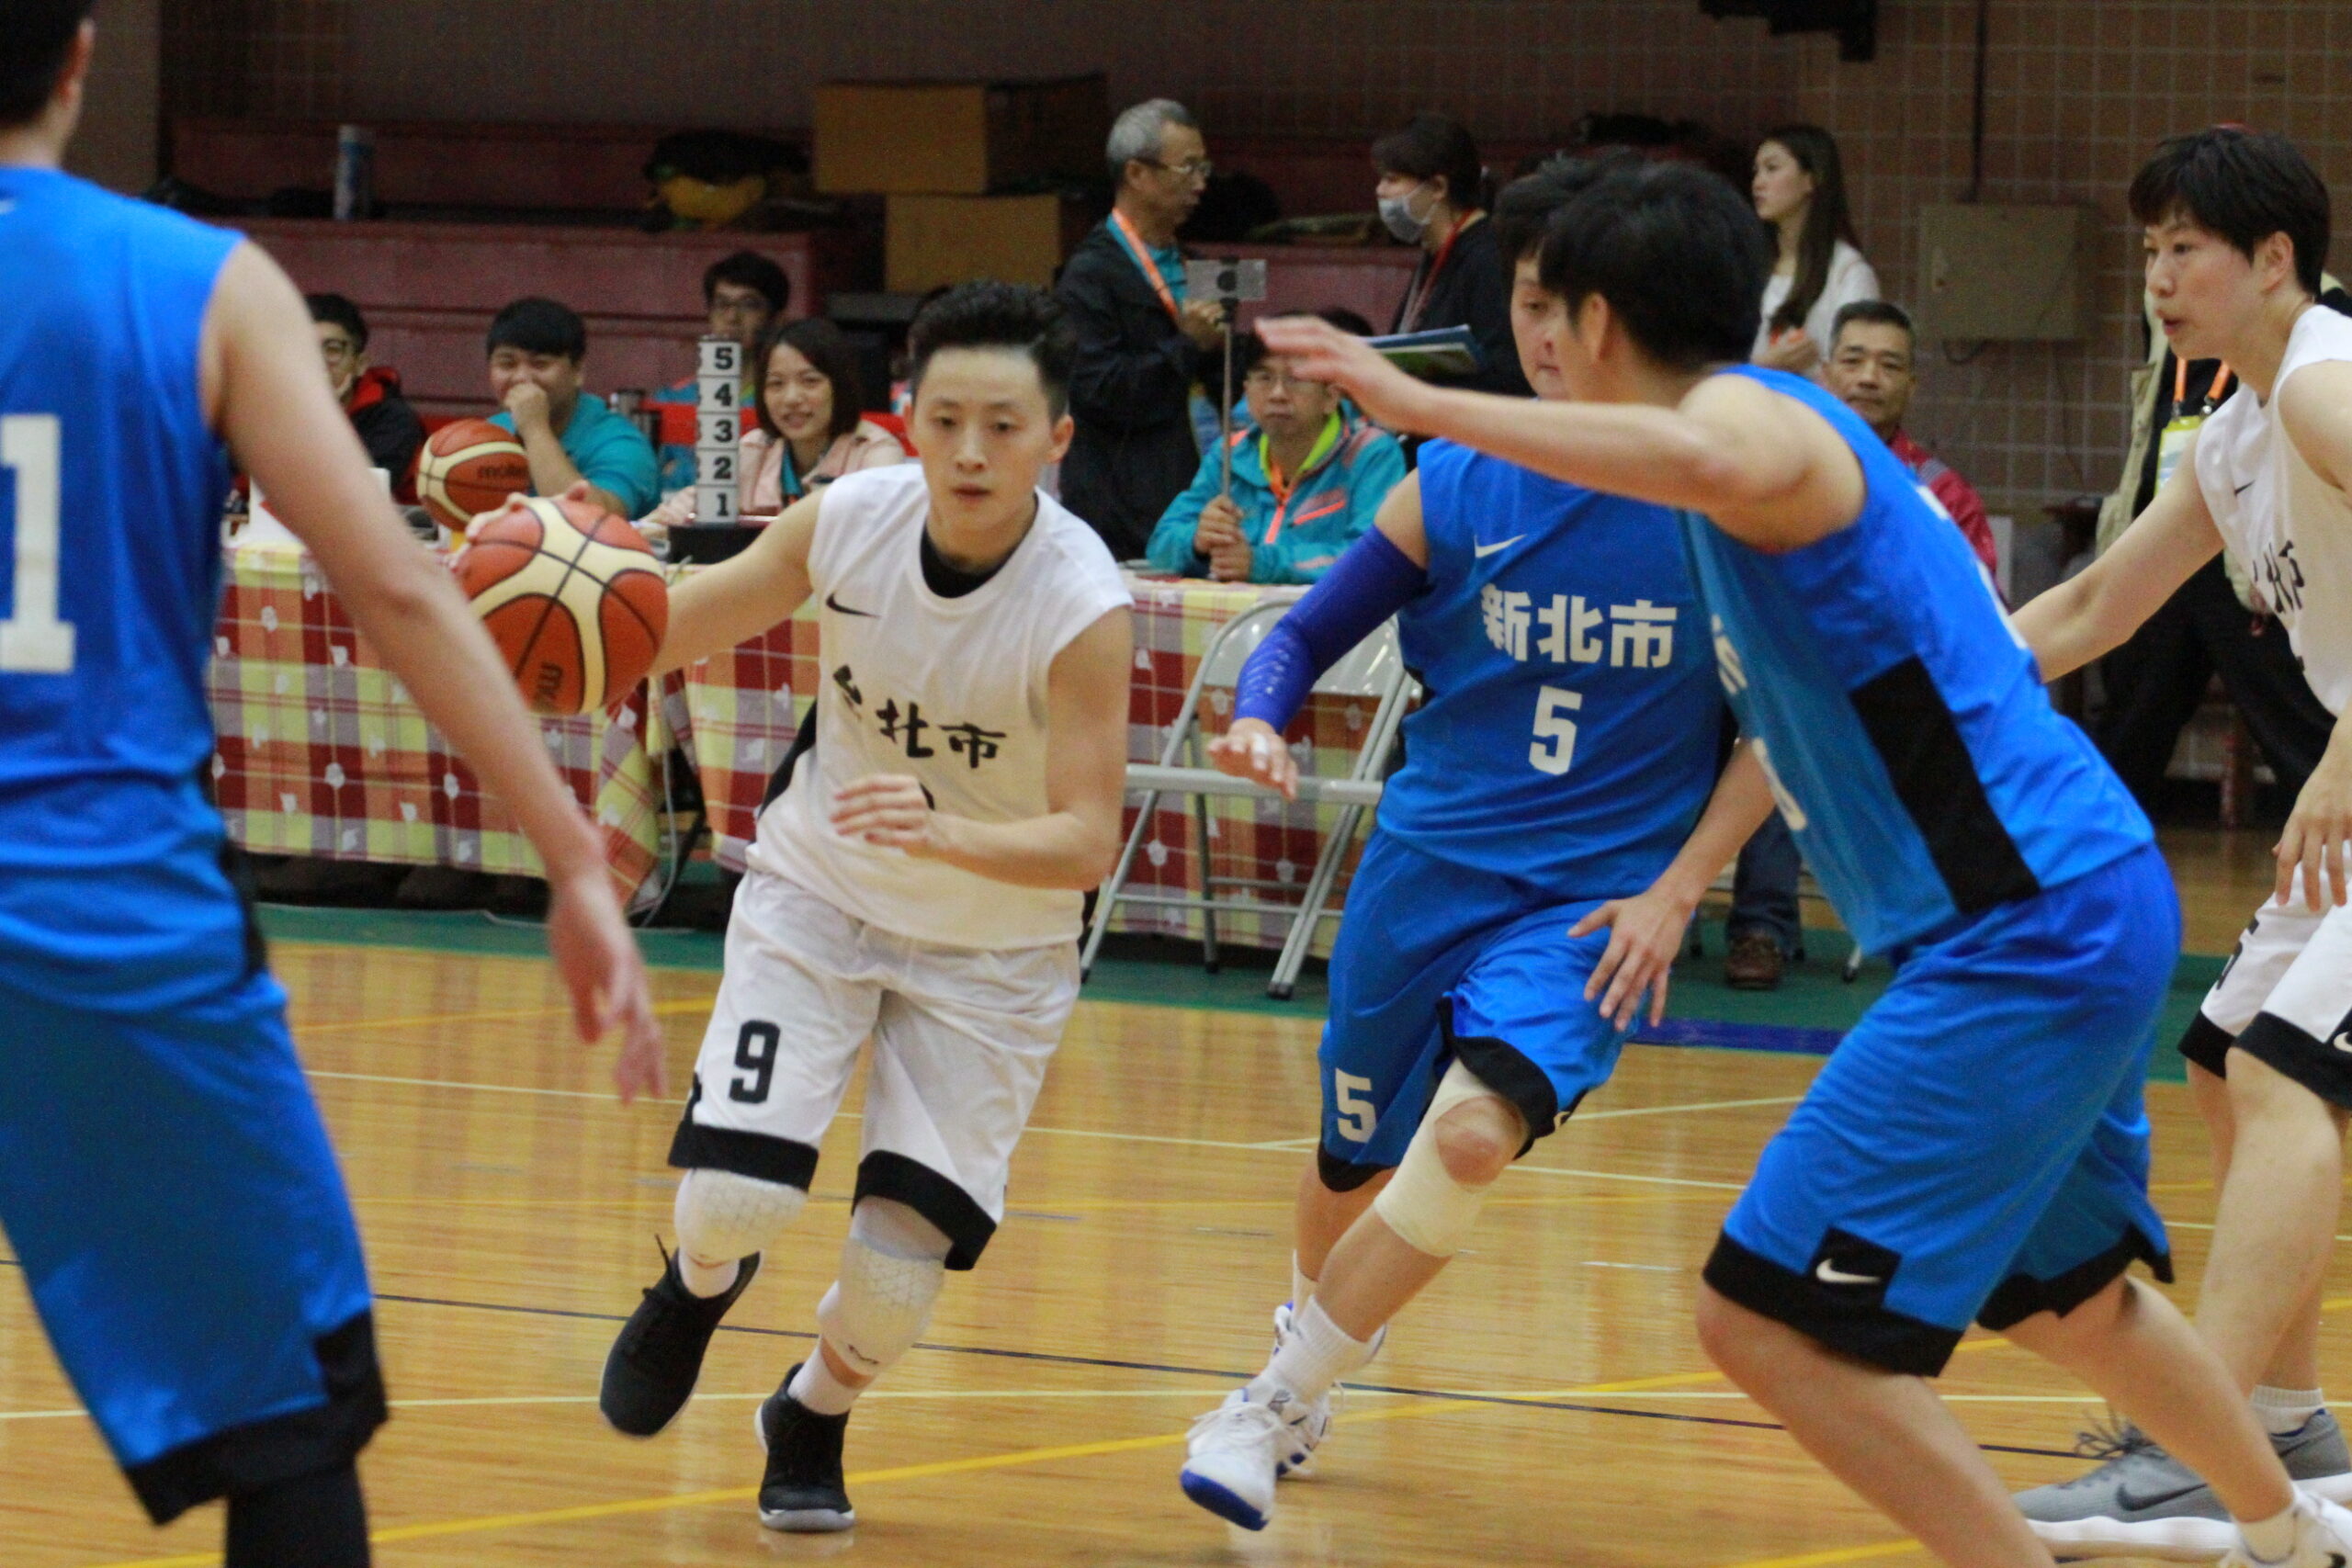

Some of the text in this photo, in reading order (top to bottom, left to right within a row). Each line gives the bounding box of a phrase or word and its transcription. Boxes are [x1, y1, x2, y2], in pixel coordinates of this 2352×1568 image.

[714, 346, 733, 370] 5
[714, 383, 732, 407] 4
[713, 419, 733, 443] 3
[713, 457, 732, 479] 2
[716, 492, 729, 516] 1
[1480, 581, 1678, 669] 新北市
[1528, 684, 1583, 775] 5
[729, 1019, 781, 1104] 9
[1335, 1067, 1377, 1144] 5
